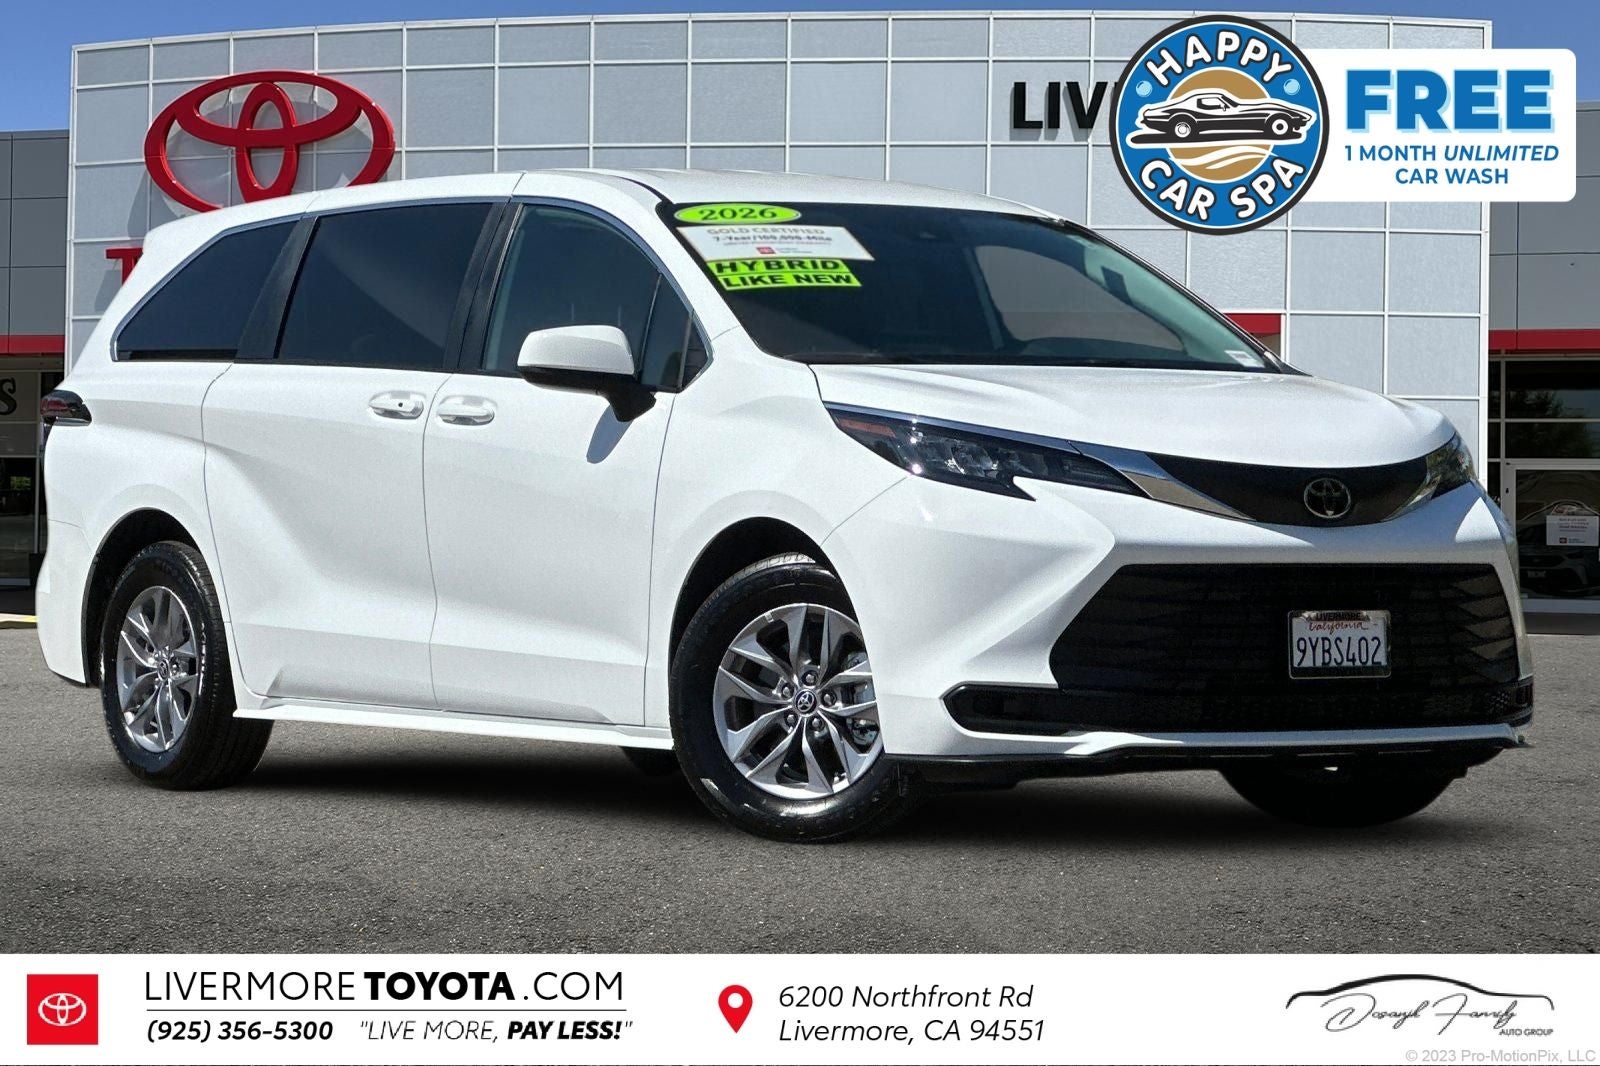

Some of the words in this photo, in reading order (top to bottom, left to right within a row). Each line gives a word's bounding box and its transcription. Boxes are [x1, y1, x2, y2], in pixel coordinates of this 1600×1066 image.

[1013, 82, 1119, 129] LIV
[700, 208, 777, 220] 2026
[716, 260, 840, 273] HYBRID
[724, 275, 785, 288] LIKE
[792, 273, 851, 286] NEW
[1297, 636, 1382, 667] 9YBS402
